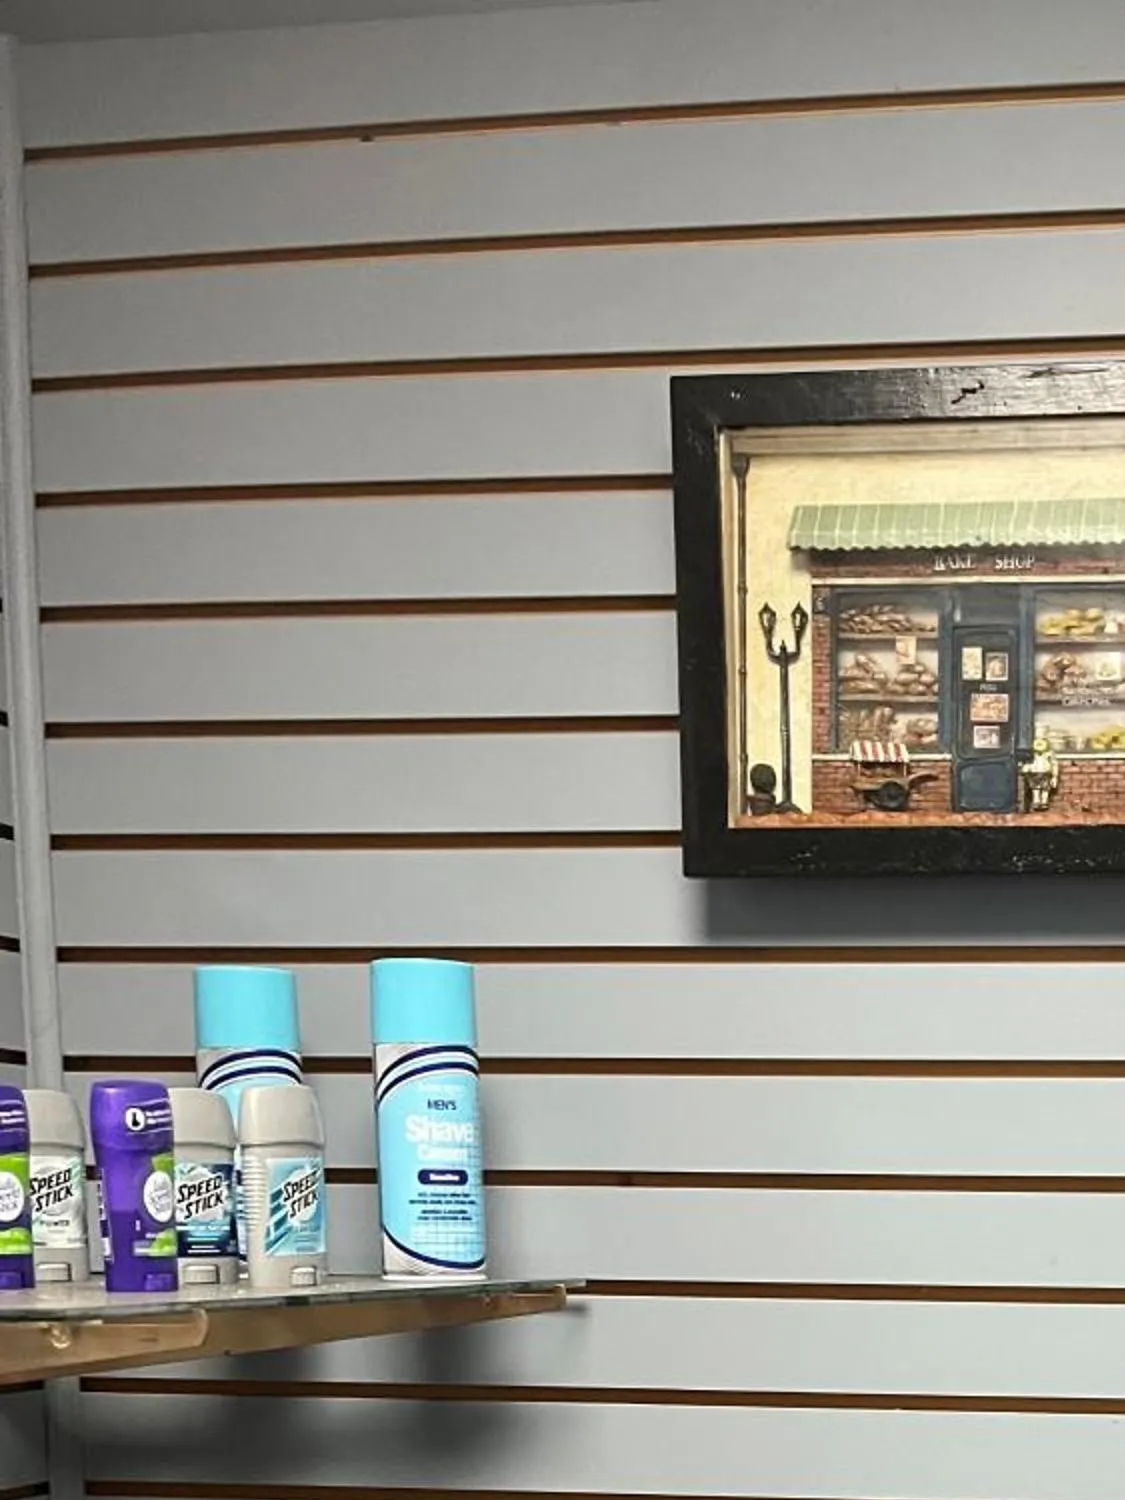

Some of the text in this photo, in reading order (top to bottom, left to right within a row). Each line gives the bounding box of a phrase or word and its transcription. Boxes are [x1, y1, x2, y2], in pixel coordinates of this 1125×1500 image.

[994, 551, 1035, 569] SHOP
[427, 1099, 457, 1110] MEN'S
[405, 1115, 475, 1143] Shave
[30, 1168, 72, 1195] SPEED
[177, 1176, 223, 1204] SPEED
[283, 1169, 320, 1202] SPEED
[35, 1185, 73, 1212] STICK
[184, 1191, 224, 1220] STICK
[290, 1192, 319, 1219] STICK
